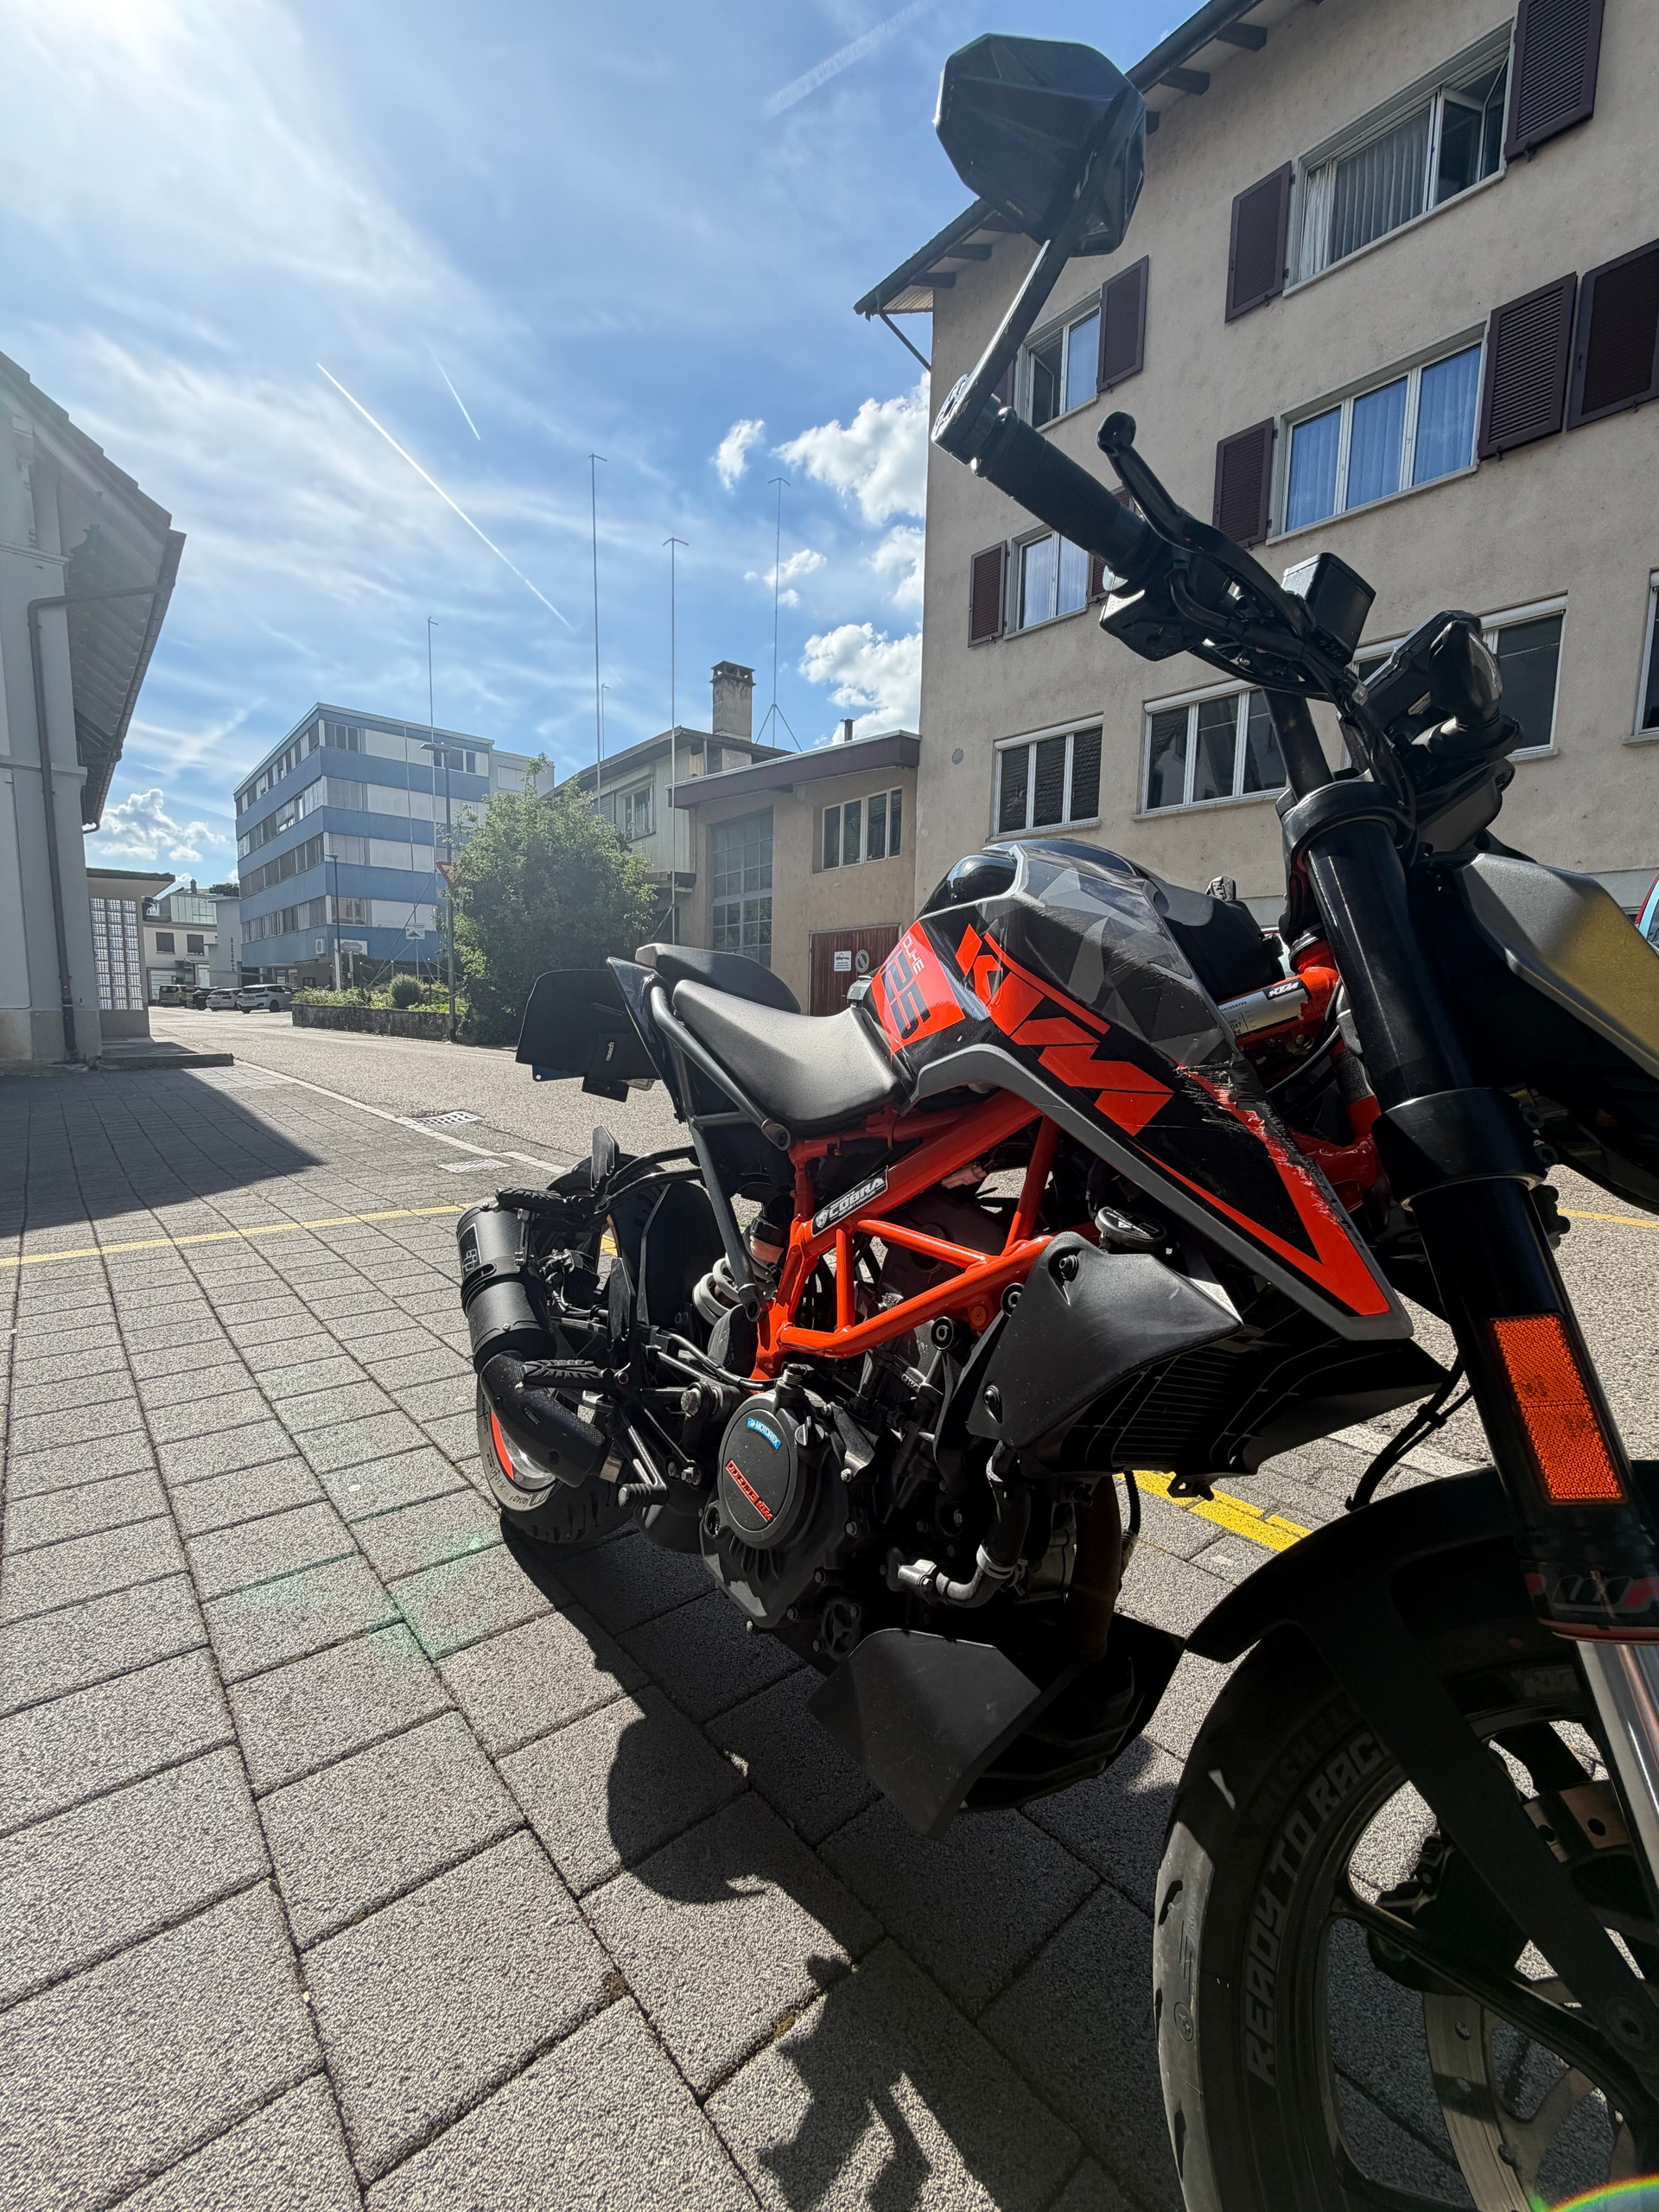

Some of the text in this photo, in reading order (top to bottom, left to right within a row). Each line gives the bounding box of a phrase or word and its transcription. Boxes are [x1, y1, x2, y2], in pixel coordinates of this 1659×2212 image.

[902, 935, 925, 976] DUKE
[880, 945, 931, 1039] 125
[1268, 982, 1300, 998] KTM
[954, 923, 1175, 1137] KTM
[829, 1178, 885, 1218] COBRA
[755, 1421, 779, 1446] MOTOREX
[756, 1500, 773, 1522] KTM
[1523, 1668, 1580, 1700] KTM
[1249, 1695, 1363, 1820] MICHEL
[1245, 1731, 1393, 2088] READY TO RAC
